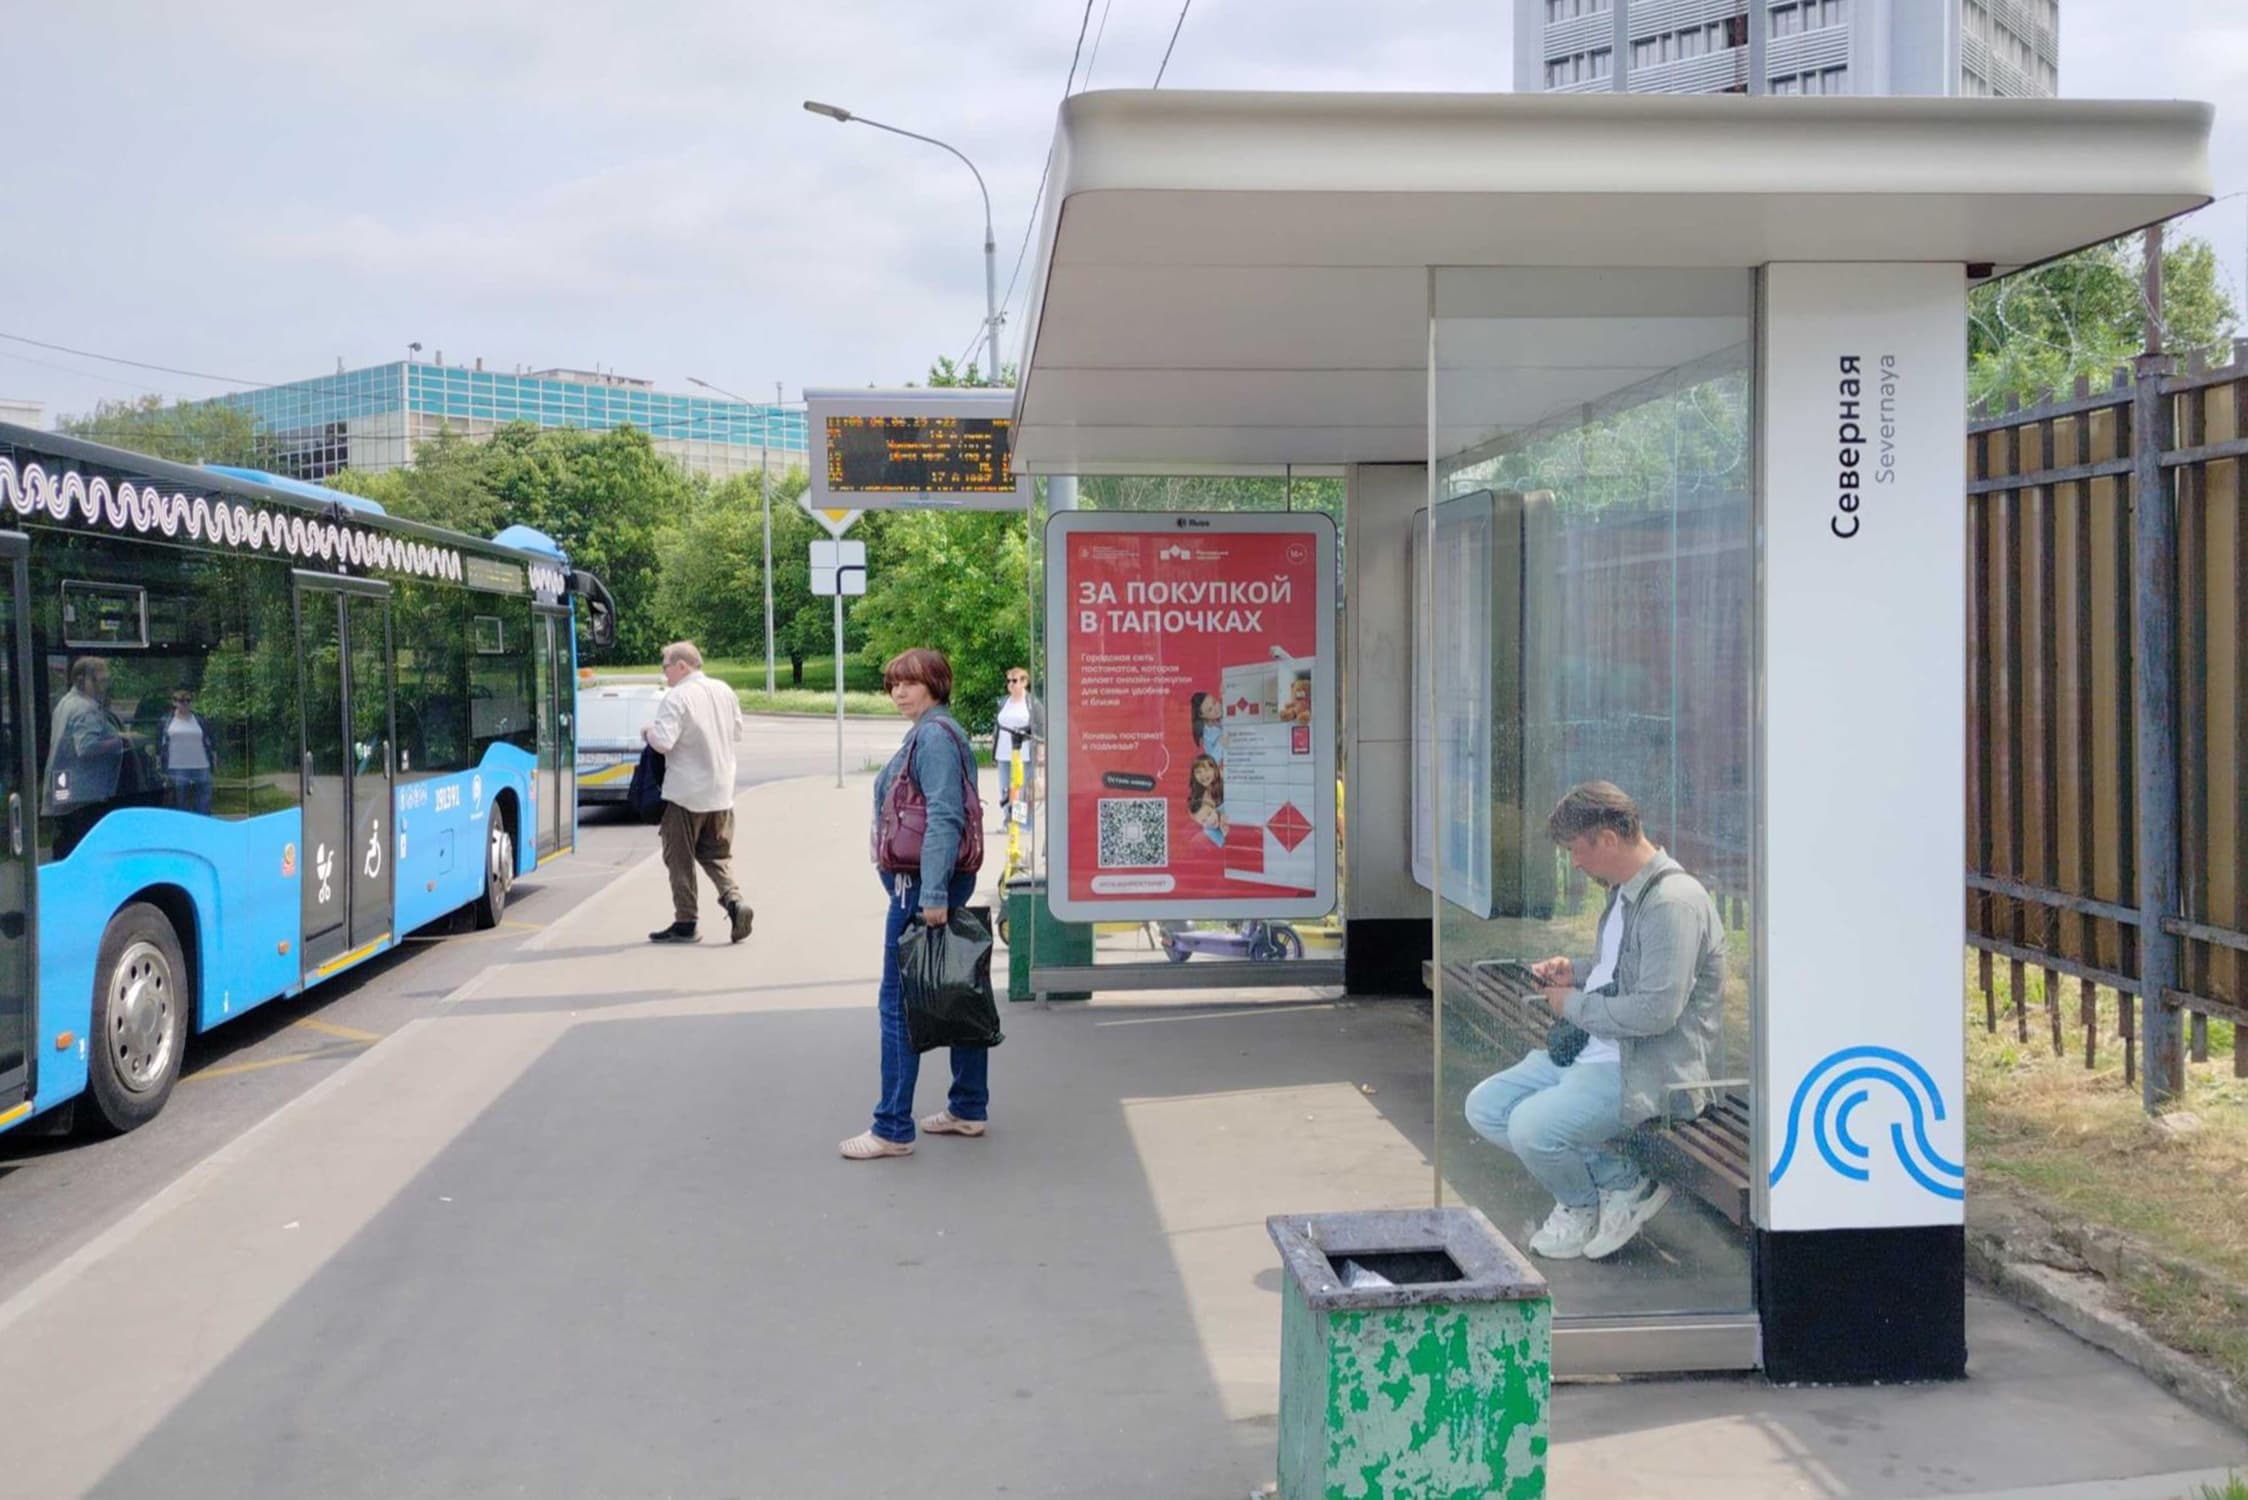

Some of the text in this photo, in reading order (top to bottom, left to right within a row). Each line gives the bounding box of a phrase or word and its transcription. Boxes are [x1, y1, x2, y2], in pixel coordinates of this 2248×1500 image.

[1831, 356, 1867, 539] Северная
[1875, 354, 1900, 484] Severnaya
[1079, 575, 1292, 604] ЗА ПОКУПКОЙ
[1080, 610, 1263, 633] В ТАПОЧКАХ
